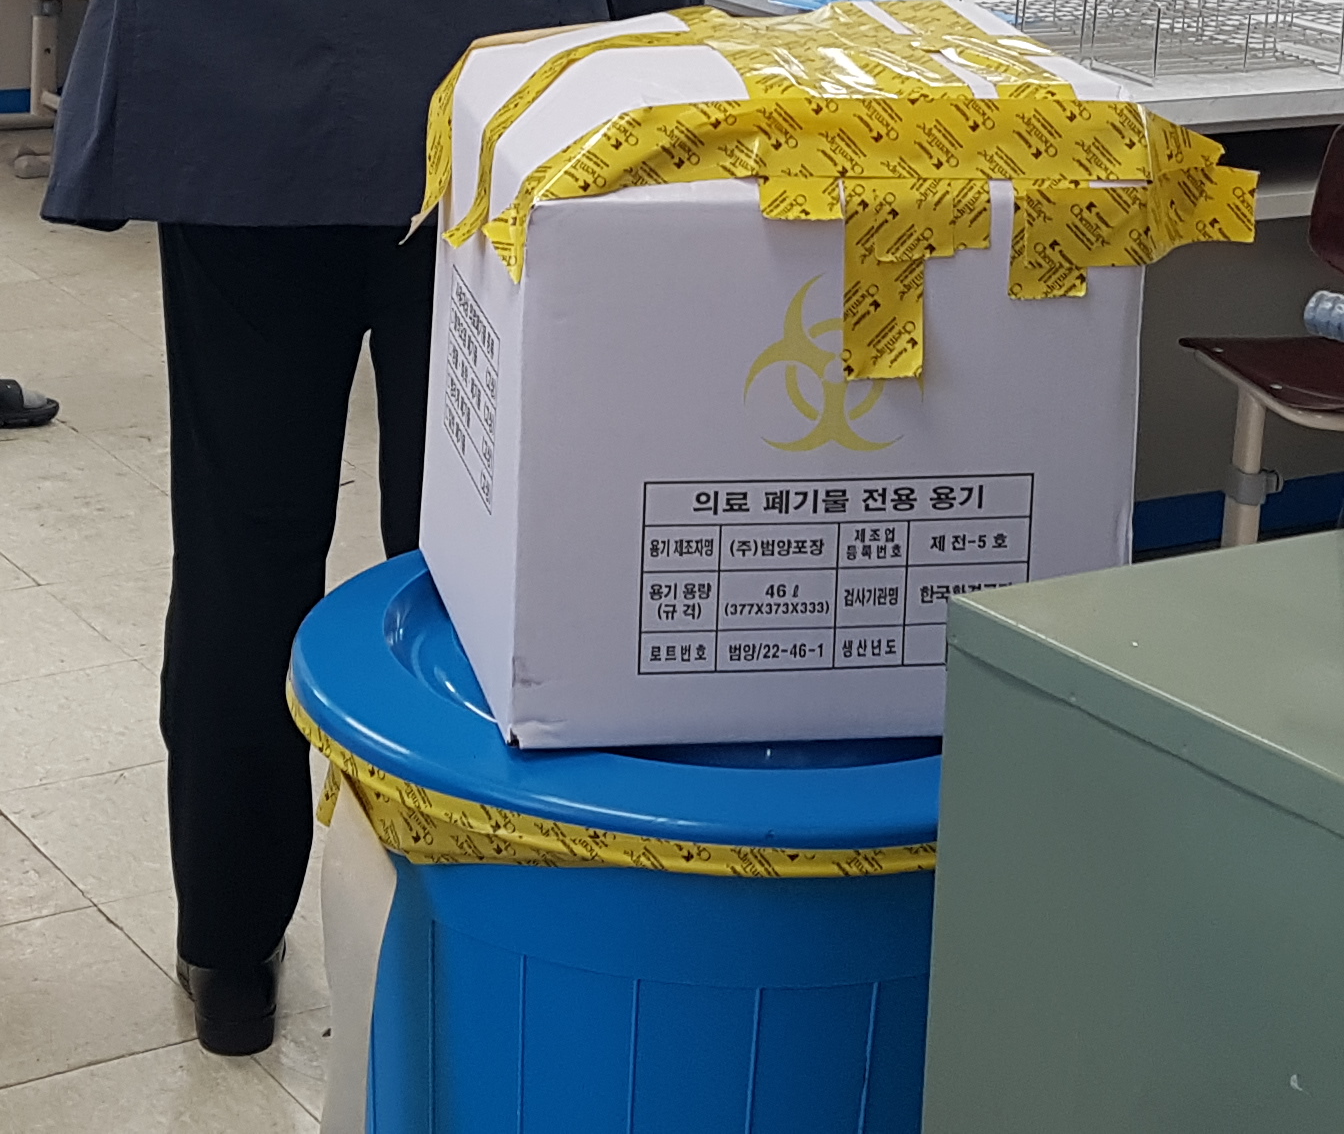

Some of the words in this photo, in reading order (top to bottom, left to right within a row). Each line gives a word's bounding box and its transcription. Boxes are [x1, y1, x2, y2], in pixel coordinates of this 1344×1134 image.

[693, 490, 750, 516] 의료
[763, 488, 849, 515] 폐기물
[862, 486, 917, 512] 전용
[929, 484, 985, 511] 용기
[854, 527, 896, 543] 제조업
[649, 538, 670, 557] 용기
[673, 538, 714, 557] 제조자명
[729, 538, 824, 558] (주)범양포장
[846, 544, 902, 561] 등록번호
[649, 582, 677, 601] 용기
[682, 582, 712, 601] 용량
[764, 584, 787, 599] 46
[843, 586, 899, 608] 검사기관명
[724, 600, 830, 617] (377X373X333)
[649, 644, 707, 662] 로트번호
[728, 642, 824, 662] 범양/22-46-1
[842, 638, 897, 659] 생산년도
